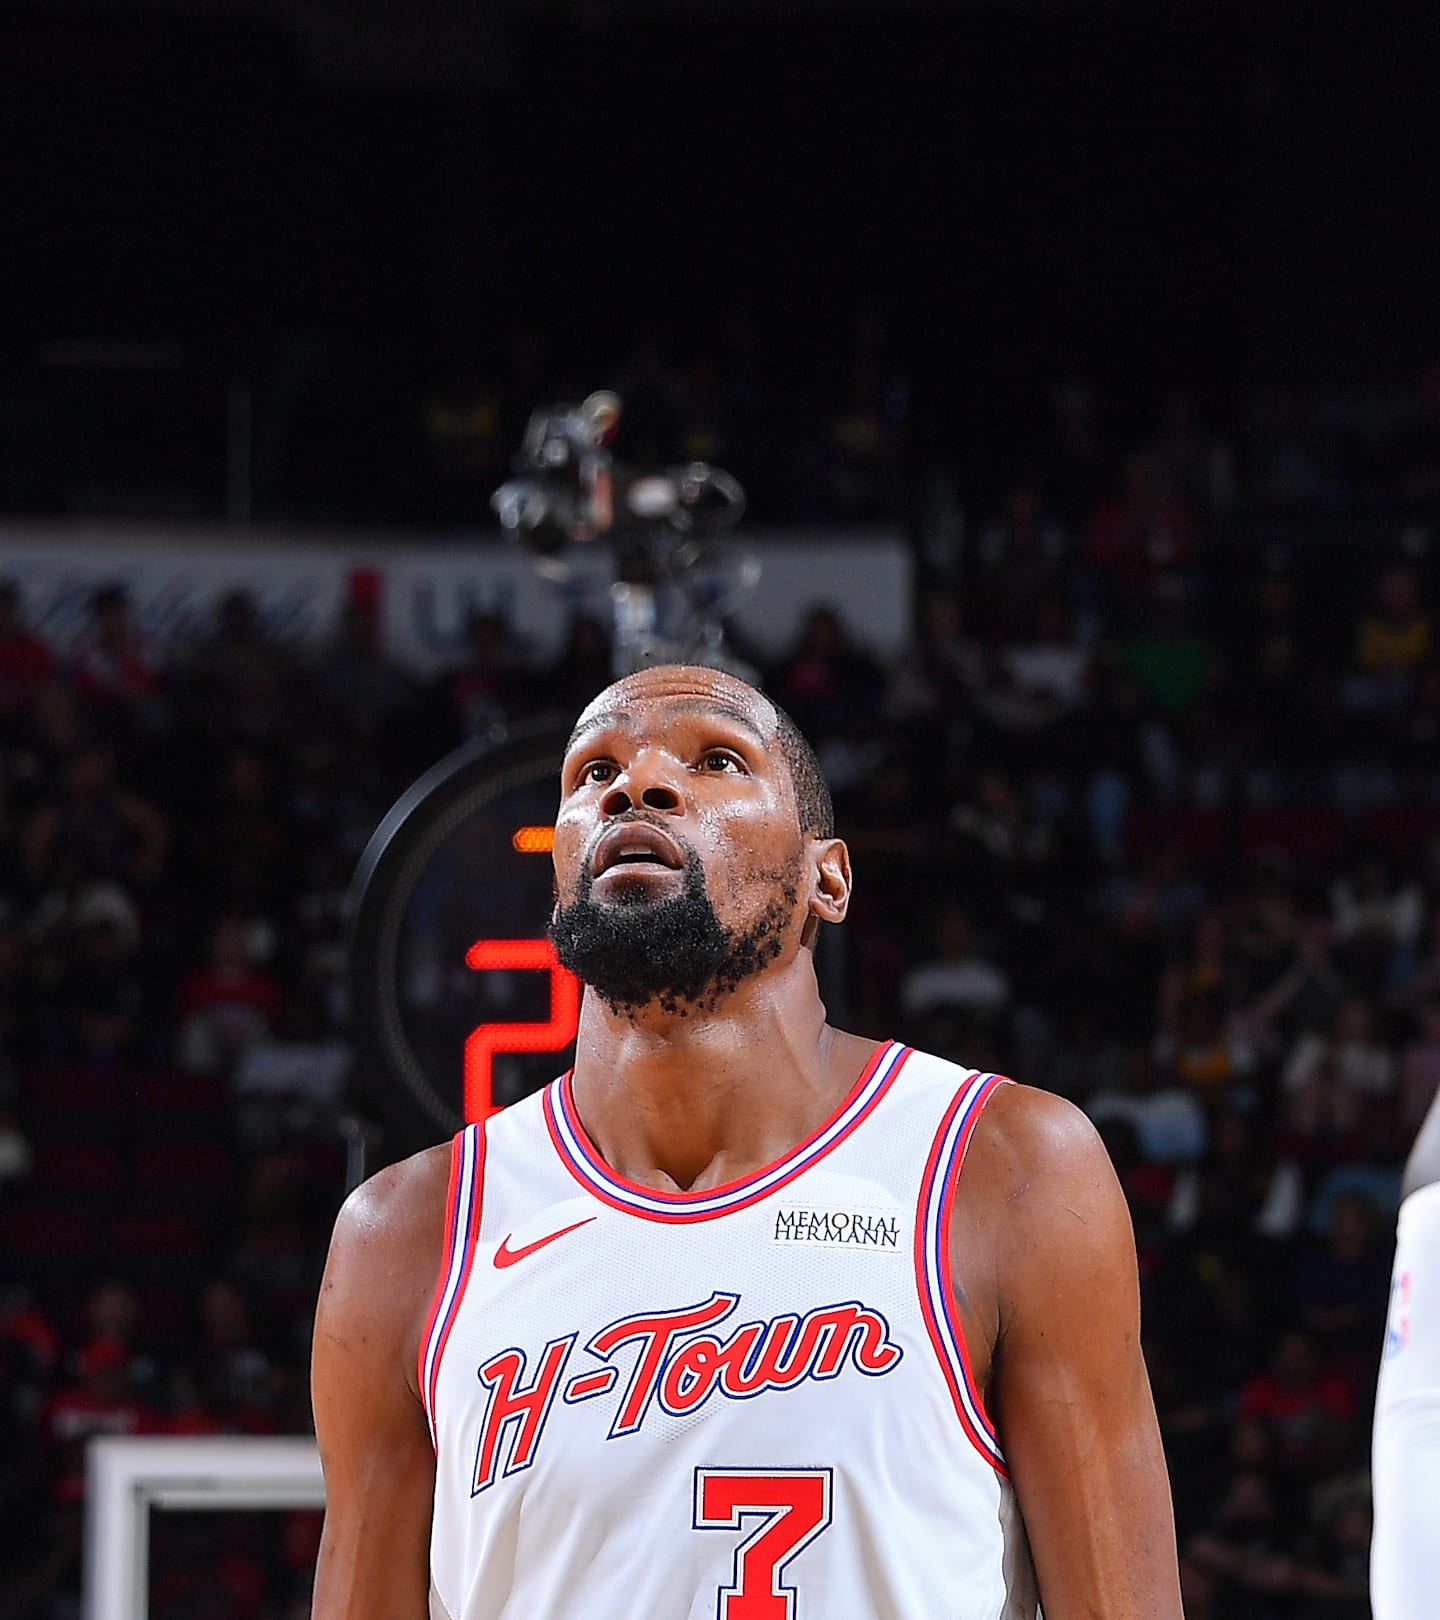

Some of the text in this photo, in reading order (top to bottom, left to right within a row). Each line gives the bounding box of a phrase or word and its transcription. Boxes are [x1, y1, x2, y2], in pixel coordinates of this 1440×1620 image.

[774, 1224, 898, 1247] HERMANN
[775, 1210, 900, 1233] MEMORIAL
[471, 1291, 902, 1498] H-Town
[692, 1467, 833, 1620] 7
